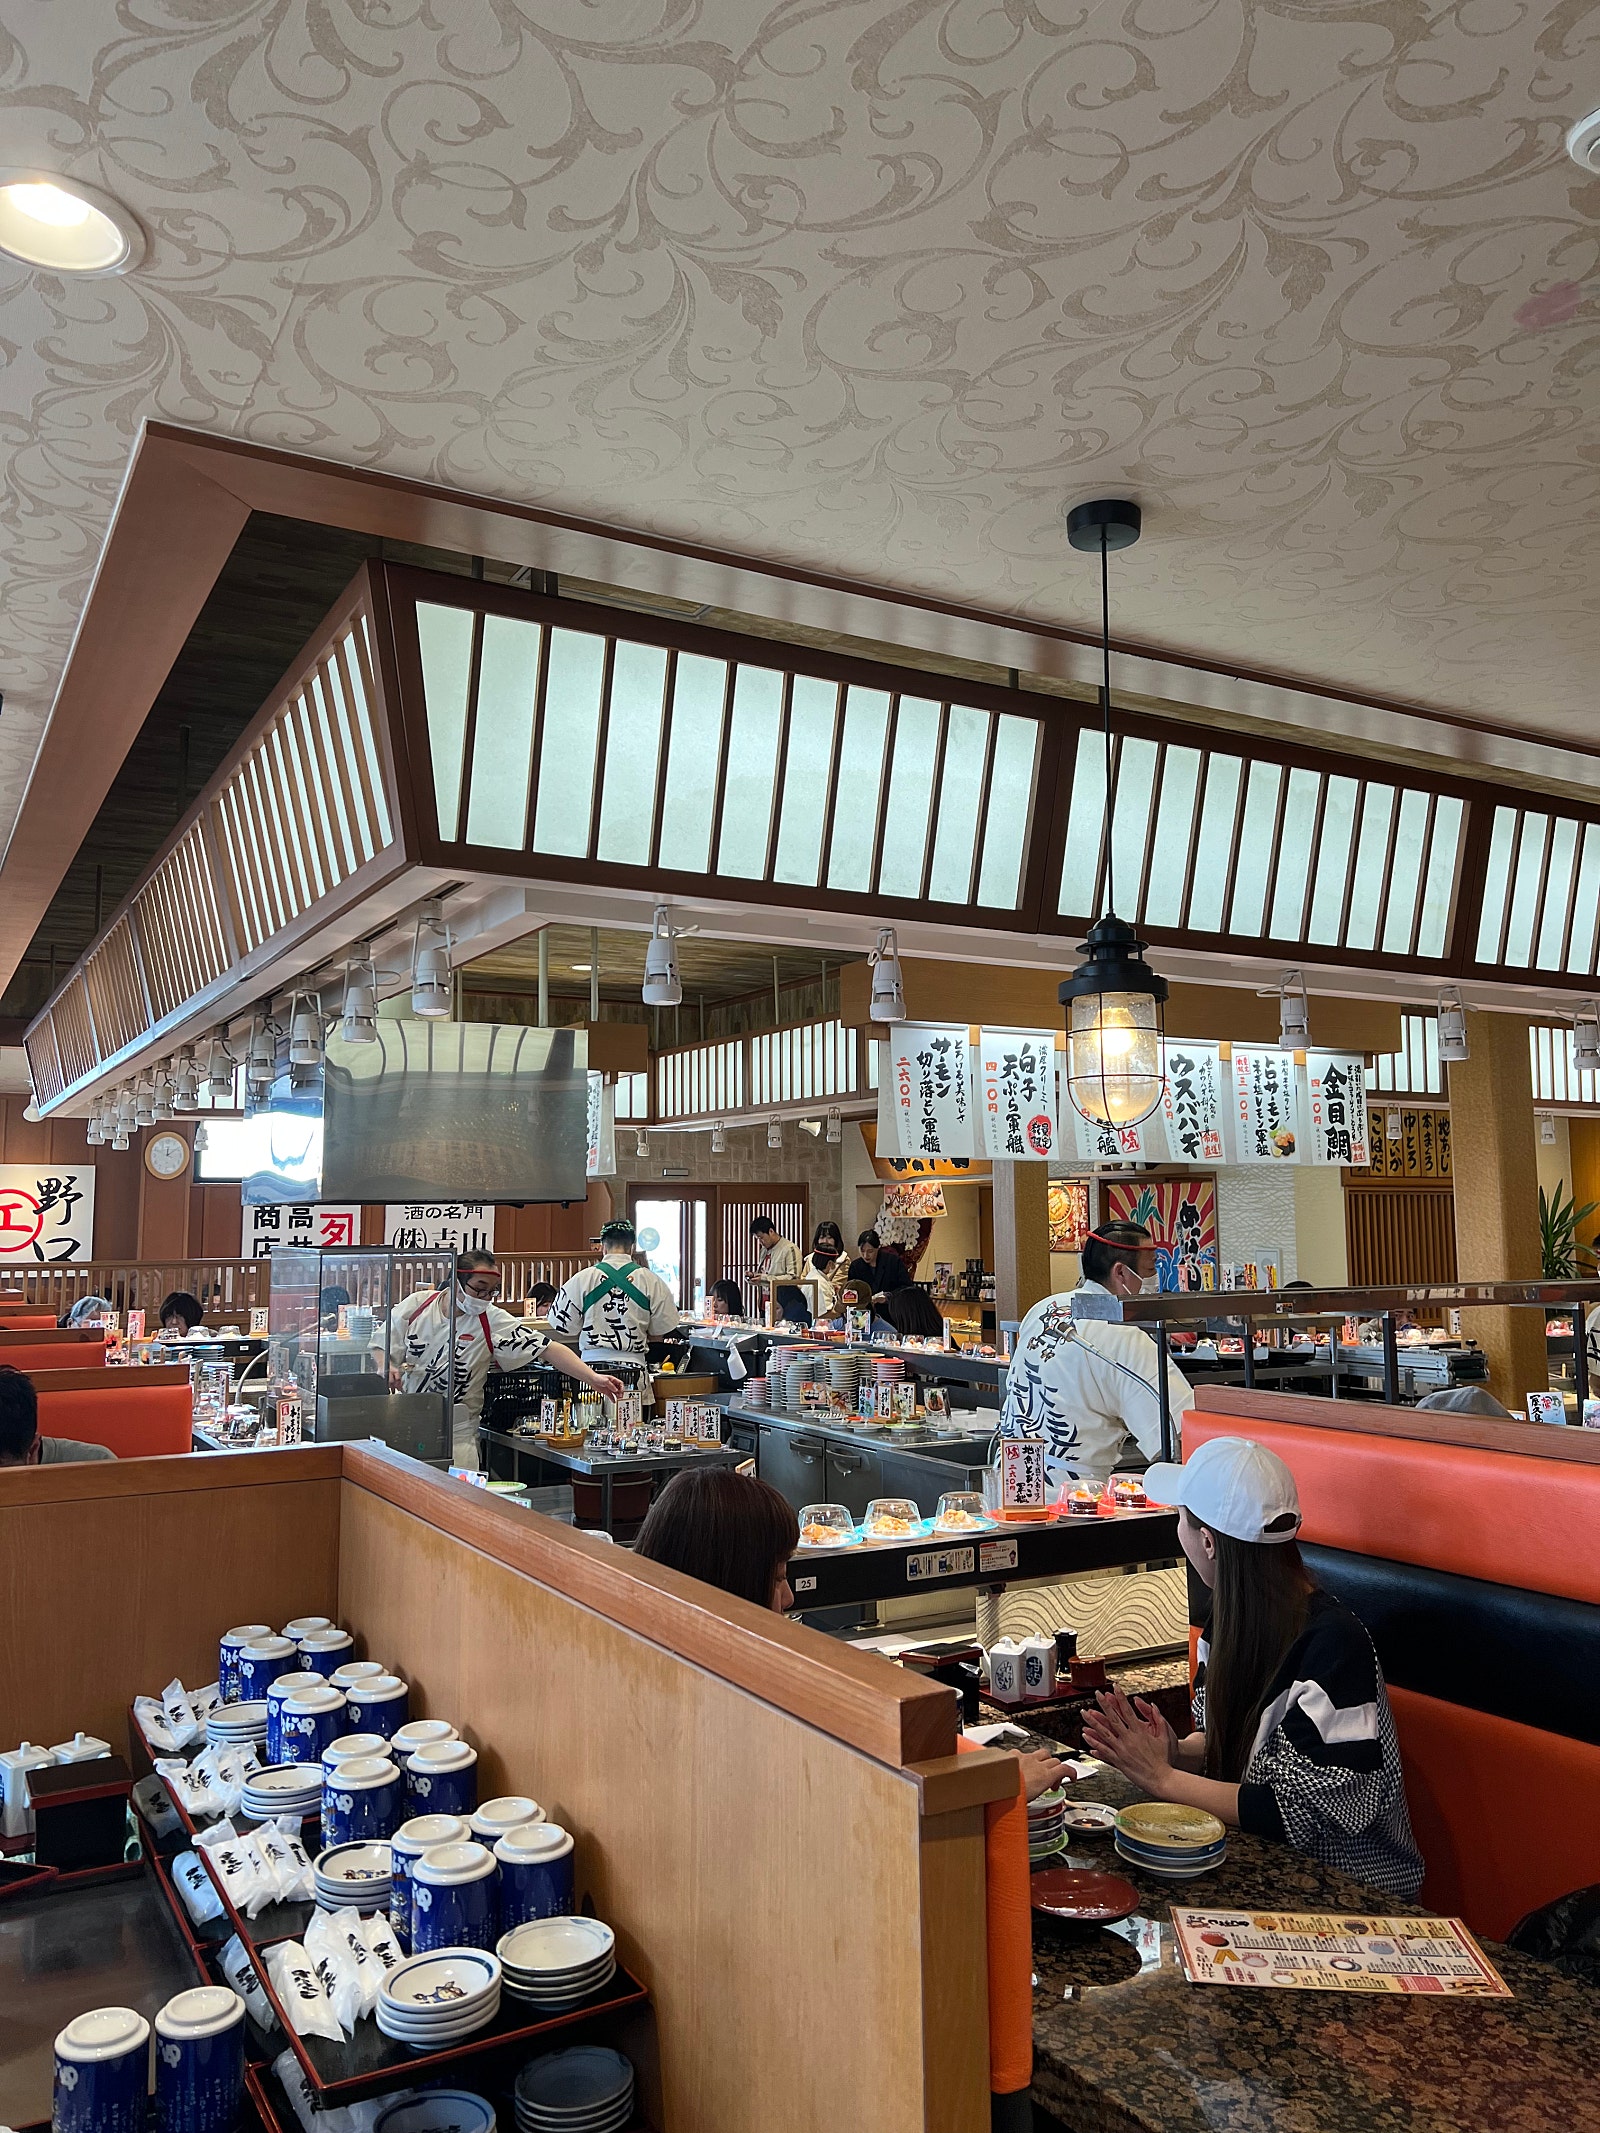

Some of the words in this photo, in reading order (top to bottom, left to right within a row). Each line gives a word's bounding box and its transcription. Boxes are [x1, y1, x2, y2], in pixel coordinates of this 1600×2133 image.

[930, 1037, 951, 1098] サーモン
[955, 1039, 966, 1125] とろける美味しさ
[1019, 1042, 1037, 1103] 白子
[1264, 1055, 1279, 1130] トロサーモン
[916, 1050, 941, 1153] 切り落とし軍艦
[999, 1054, 1025, 1155] 天ぷら軍艦
[1170, 1053, 1203, 1159] ウスバハギ
[1322, 1062, 1352, 1163] 金目鯛
[1371, 1112, 1384, 1173] こはだ
[1404, 1112, 1416, 1169] 中とろ
[1422, 1112, 1433, 1171] 本まぐろ
[1438, 1116, 1450, 1172] 地あじ
[404, 1206, 483, 1220] 酒の名門
[801, 1579, 811, 1589] 25
